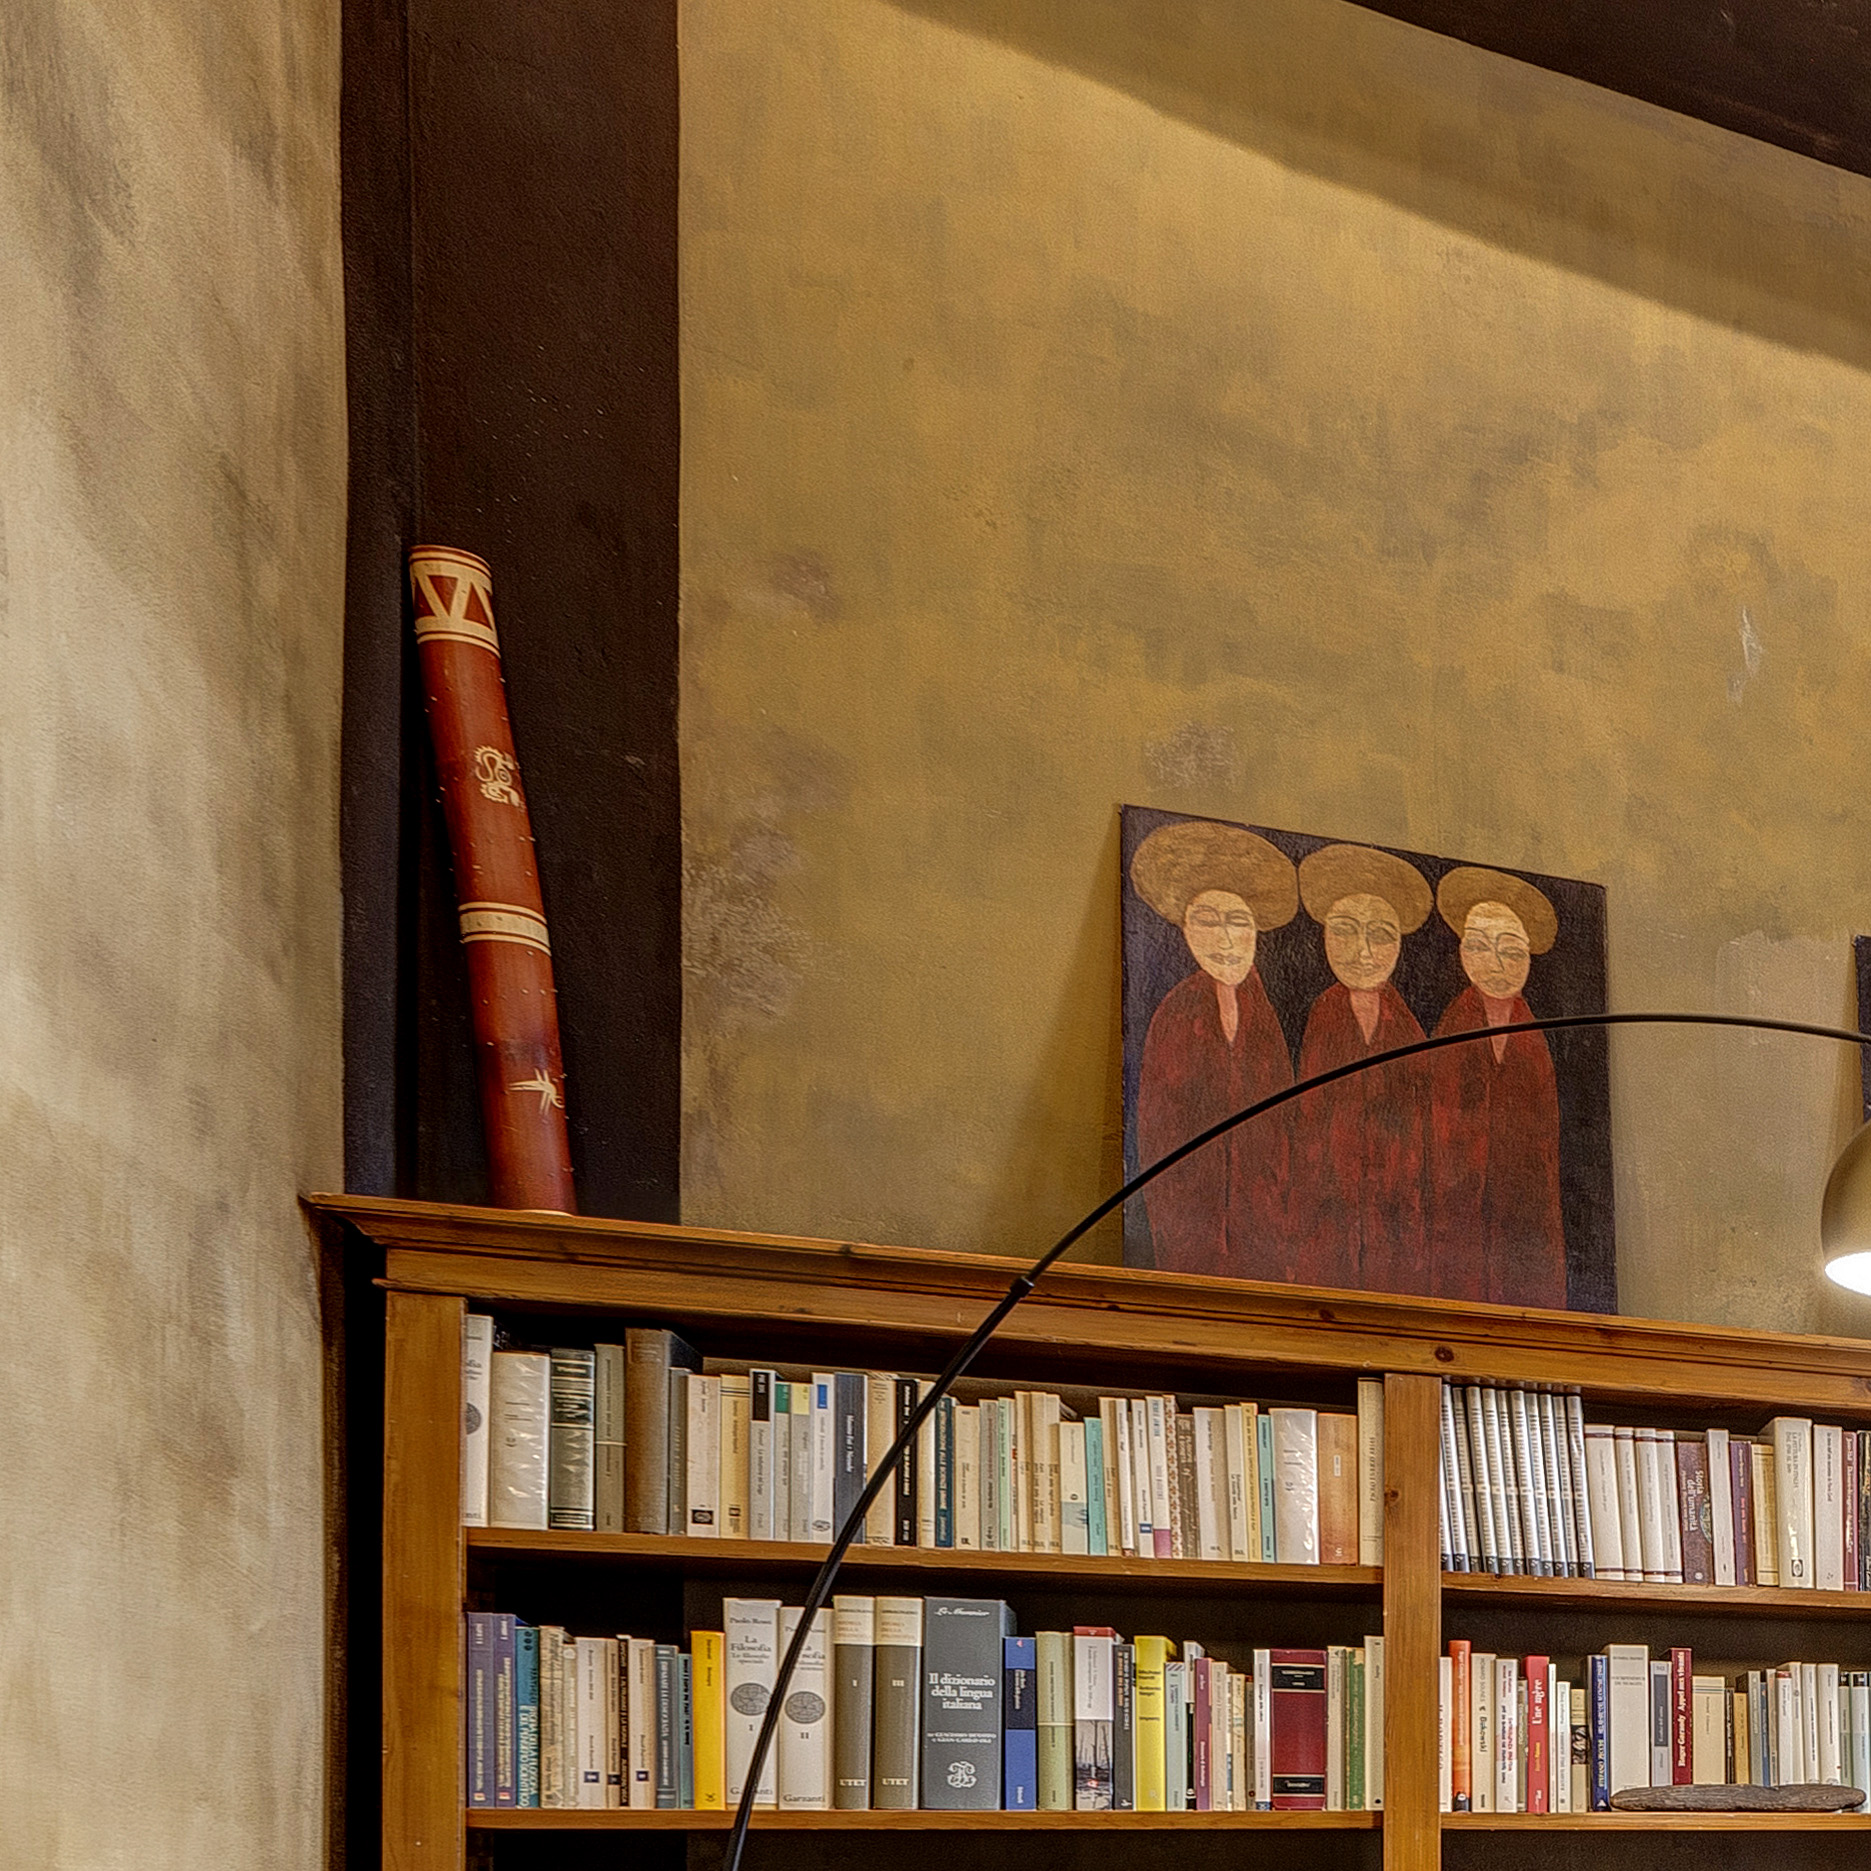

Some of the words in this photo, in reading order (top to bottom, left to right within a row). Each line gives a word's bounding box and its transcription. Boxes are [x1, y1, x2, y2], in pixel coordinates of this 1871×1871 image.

[1694, 1470, 1705, 1495] Storia
[892, 1679, 904, 1687] III
[929, 1673, 938, 1684] Il
[940, 1673, 995, 1686] dizionario
[931, 1686, 956, 1697] della
[959, 1687, 993, 1701] lingua
[942, 1698, 982, 1710] italiana
[840, 1778, 866, 1787] UTET
[882, 1778, 909, 1786] UTET
